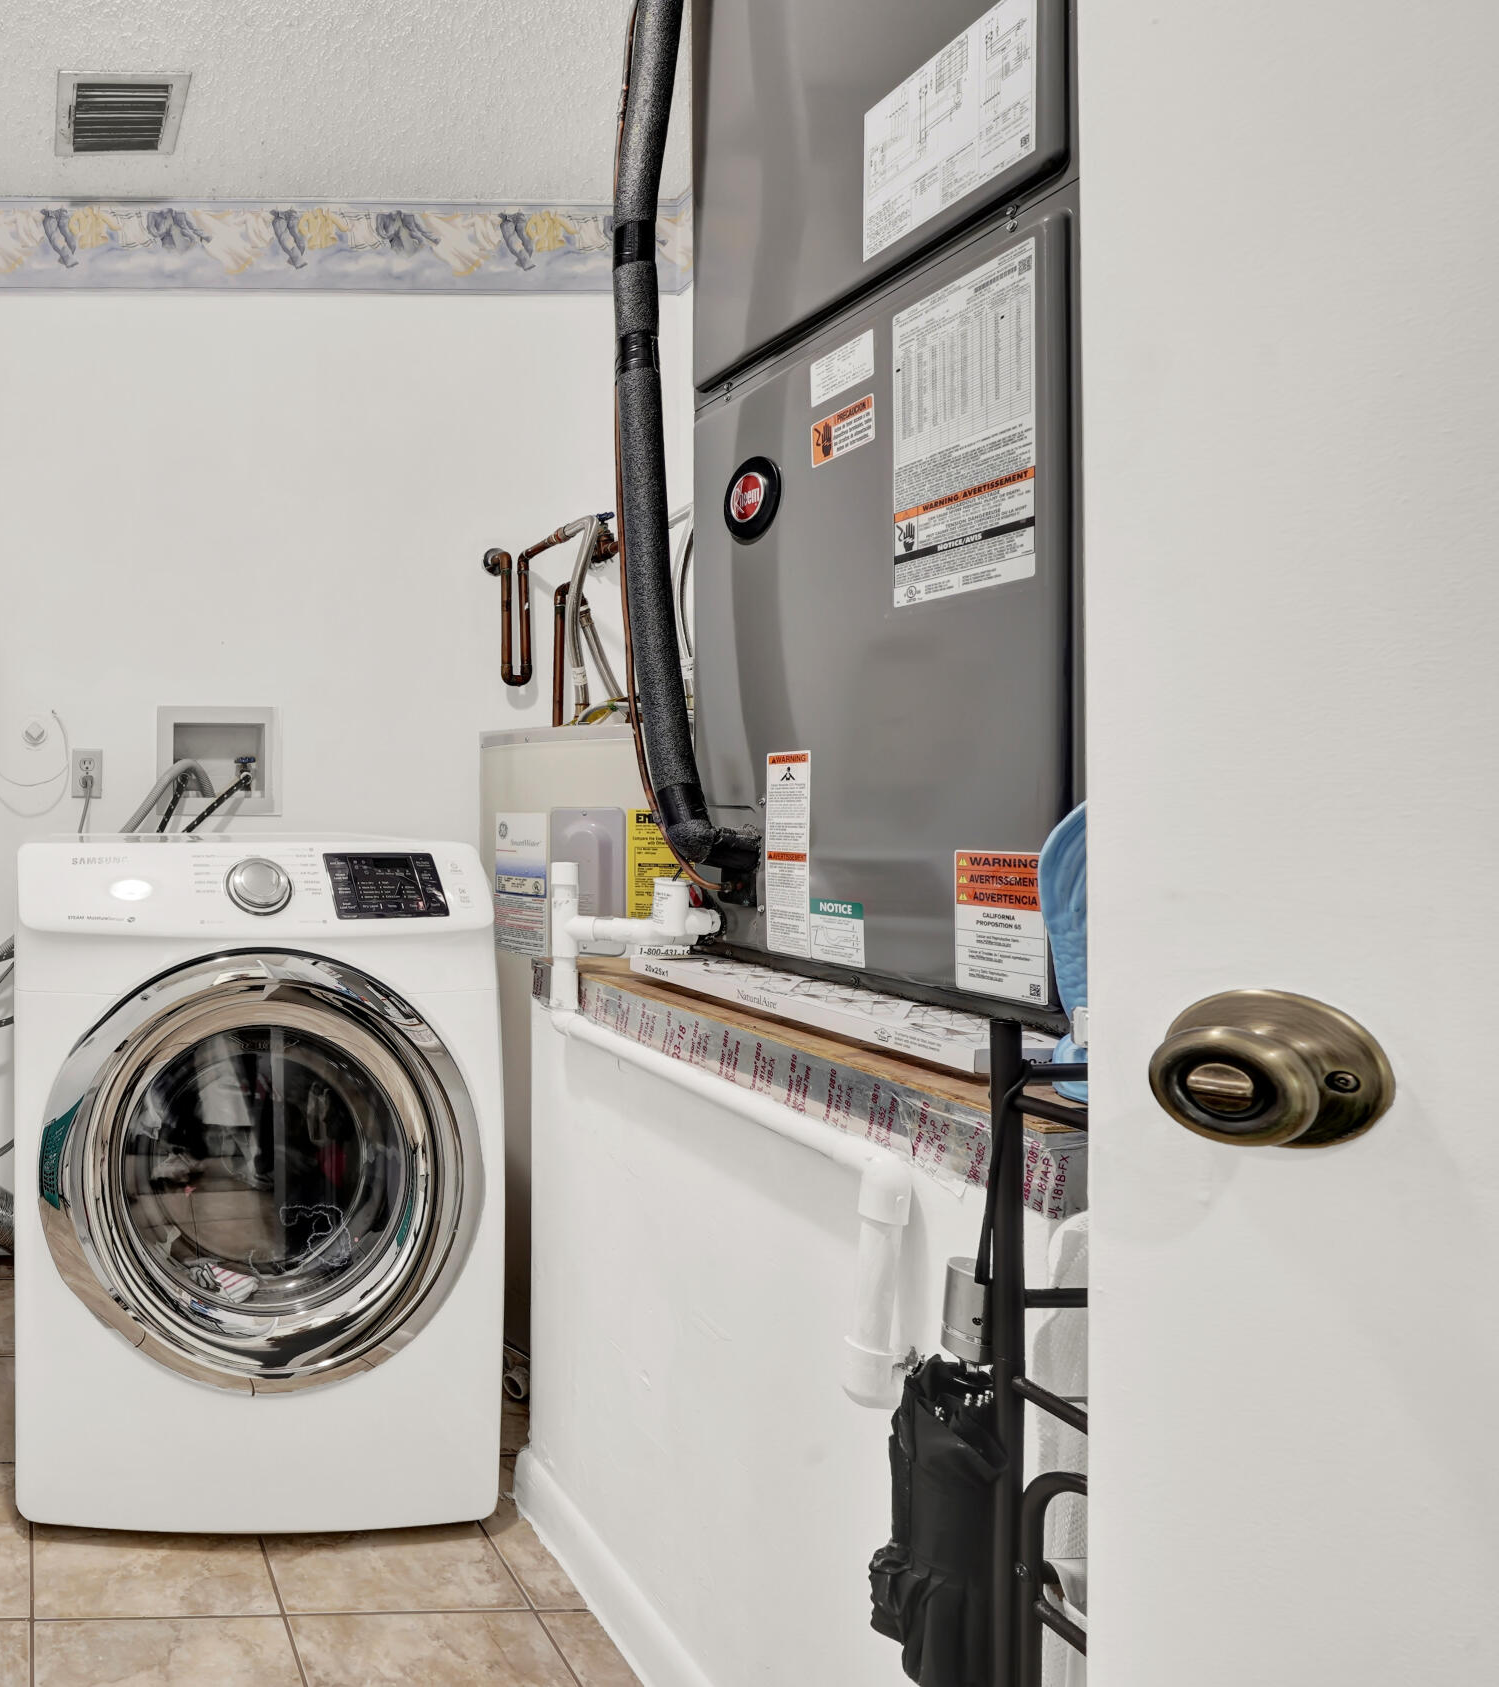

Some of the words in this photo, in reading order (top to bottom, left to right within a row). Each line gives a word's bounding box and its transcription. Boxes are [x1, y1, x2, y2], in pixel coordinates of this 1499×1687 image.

[733, 480, 760, 514] Rheem
[969, 857, 1038, 869] WARNING
[819, 902, 853, 915] NOTICE
[973, 891, 1038, 906] ADVERTENCIA
[976, 920, 1013, 929] PROPOSITION
[982, 912, 1016, 921] CALIFORNIA
[645, 964, 669, 978] 20x25x1
[736, 987, 778, 1010] NaturalAire
[871, 1083, 881, 1104] 0810
[918, 1101, 931, 1125] 0810
[1027, 1140, 1042, 1165] 0810
[1037, 1157, 1054, 1195] 181A-P
[1050, 1154, 1070, 1202] 181B-FX
